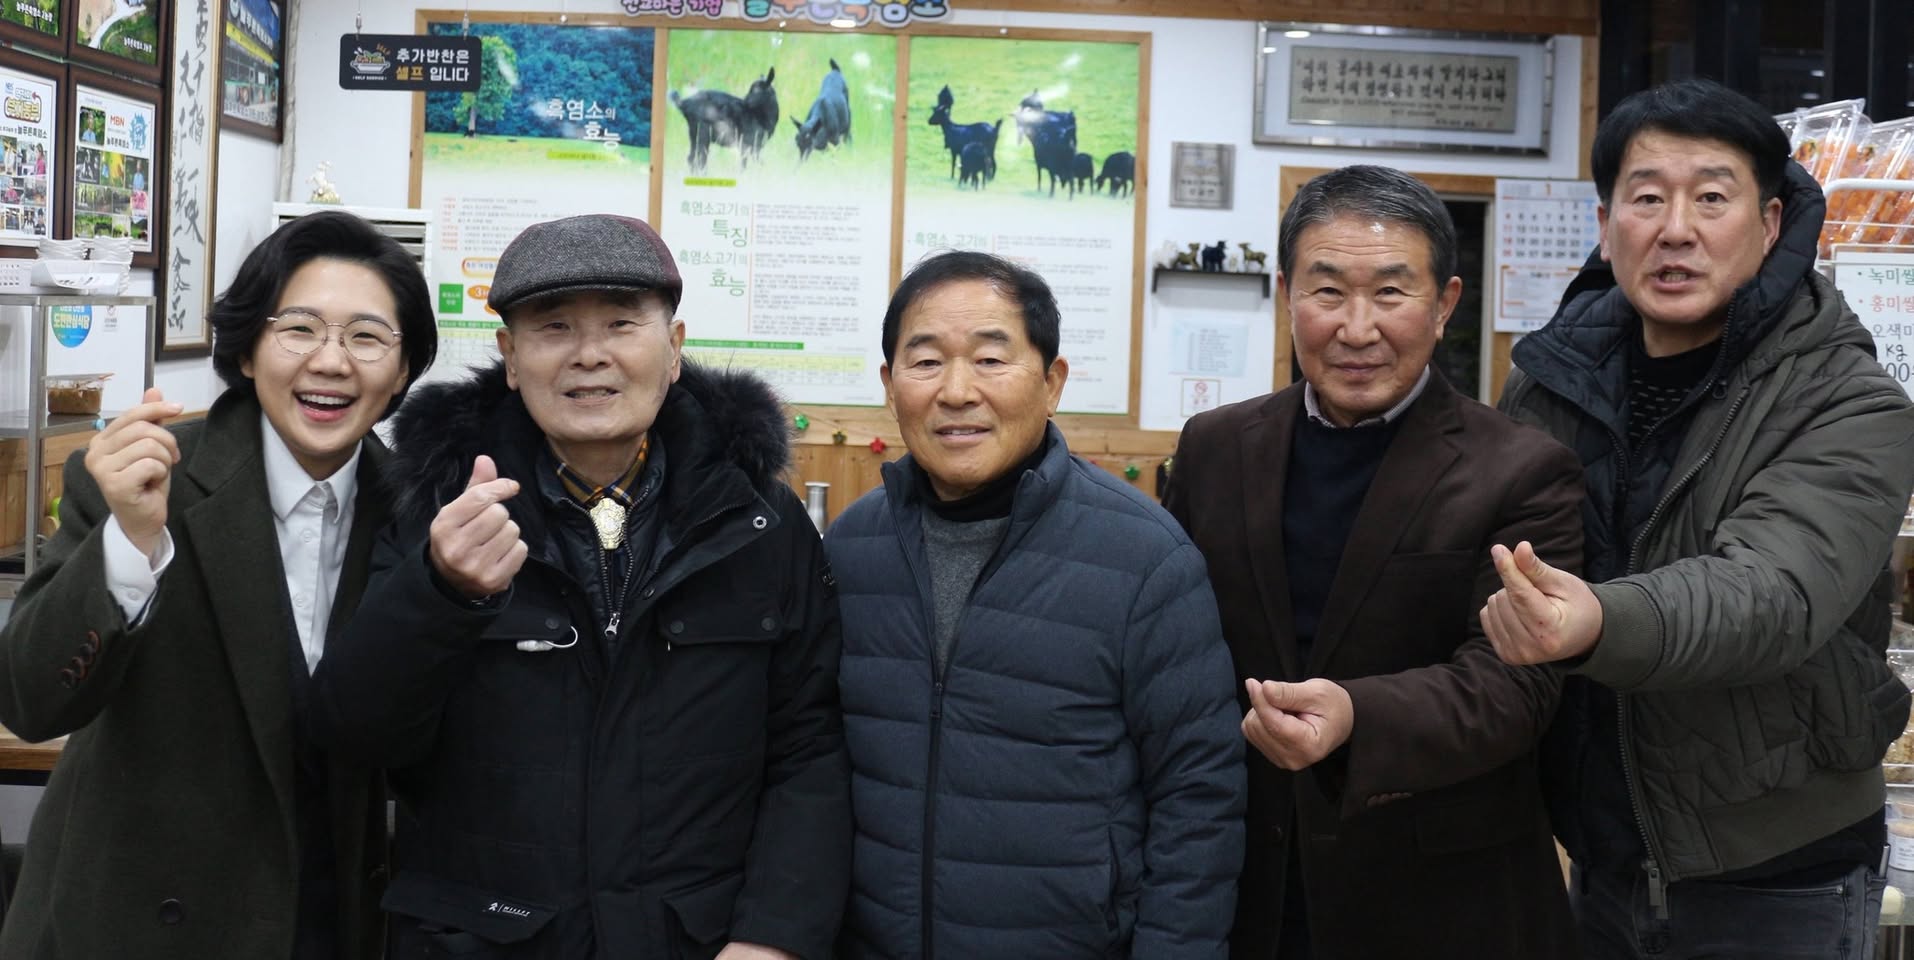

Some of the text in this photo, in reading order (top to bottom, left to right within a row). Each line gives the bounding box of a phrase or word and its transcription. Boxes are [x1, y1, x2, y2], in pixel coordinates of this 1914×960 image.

[396, 48, 469, 64] 추가반찬은
[396, 65, 469, 82] 셀프 입니다
[110, 115, 125, 127] MBN
[545, 98, 617, 121] 흑염소의
[583, 121, 622, 151] 효능
[711, 219, 748, 248] 특징
[709, 269, 747, 297] 효능
